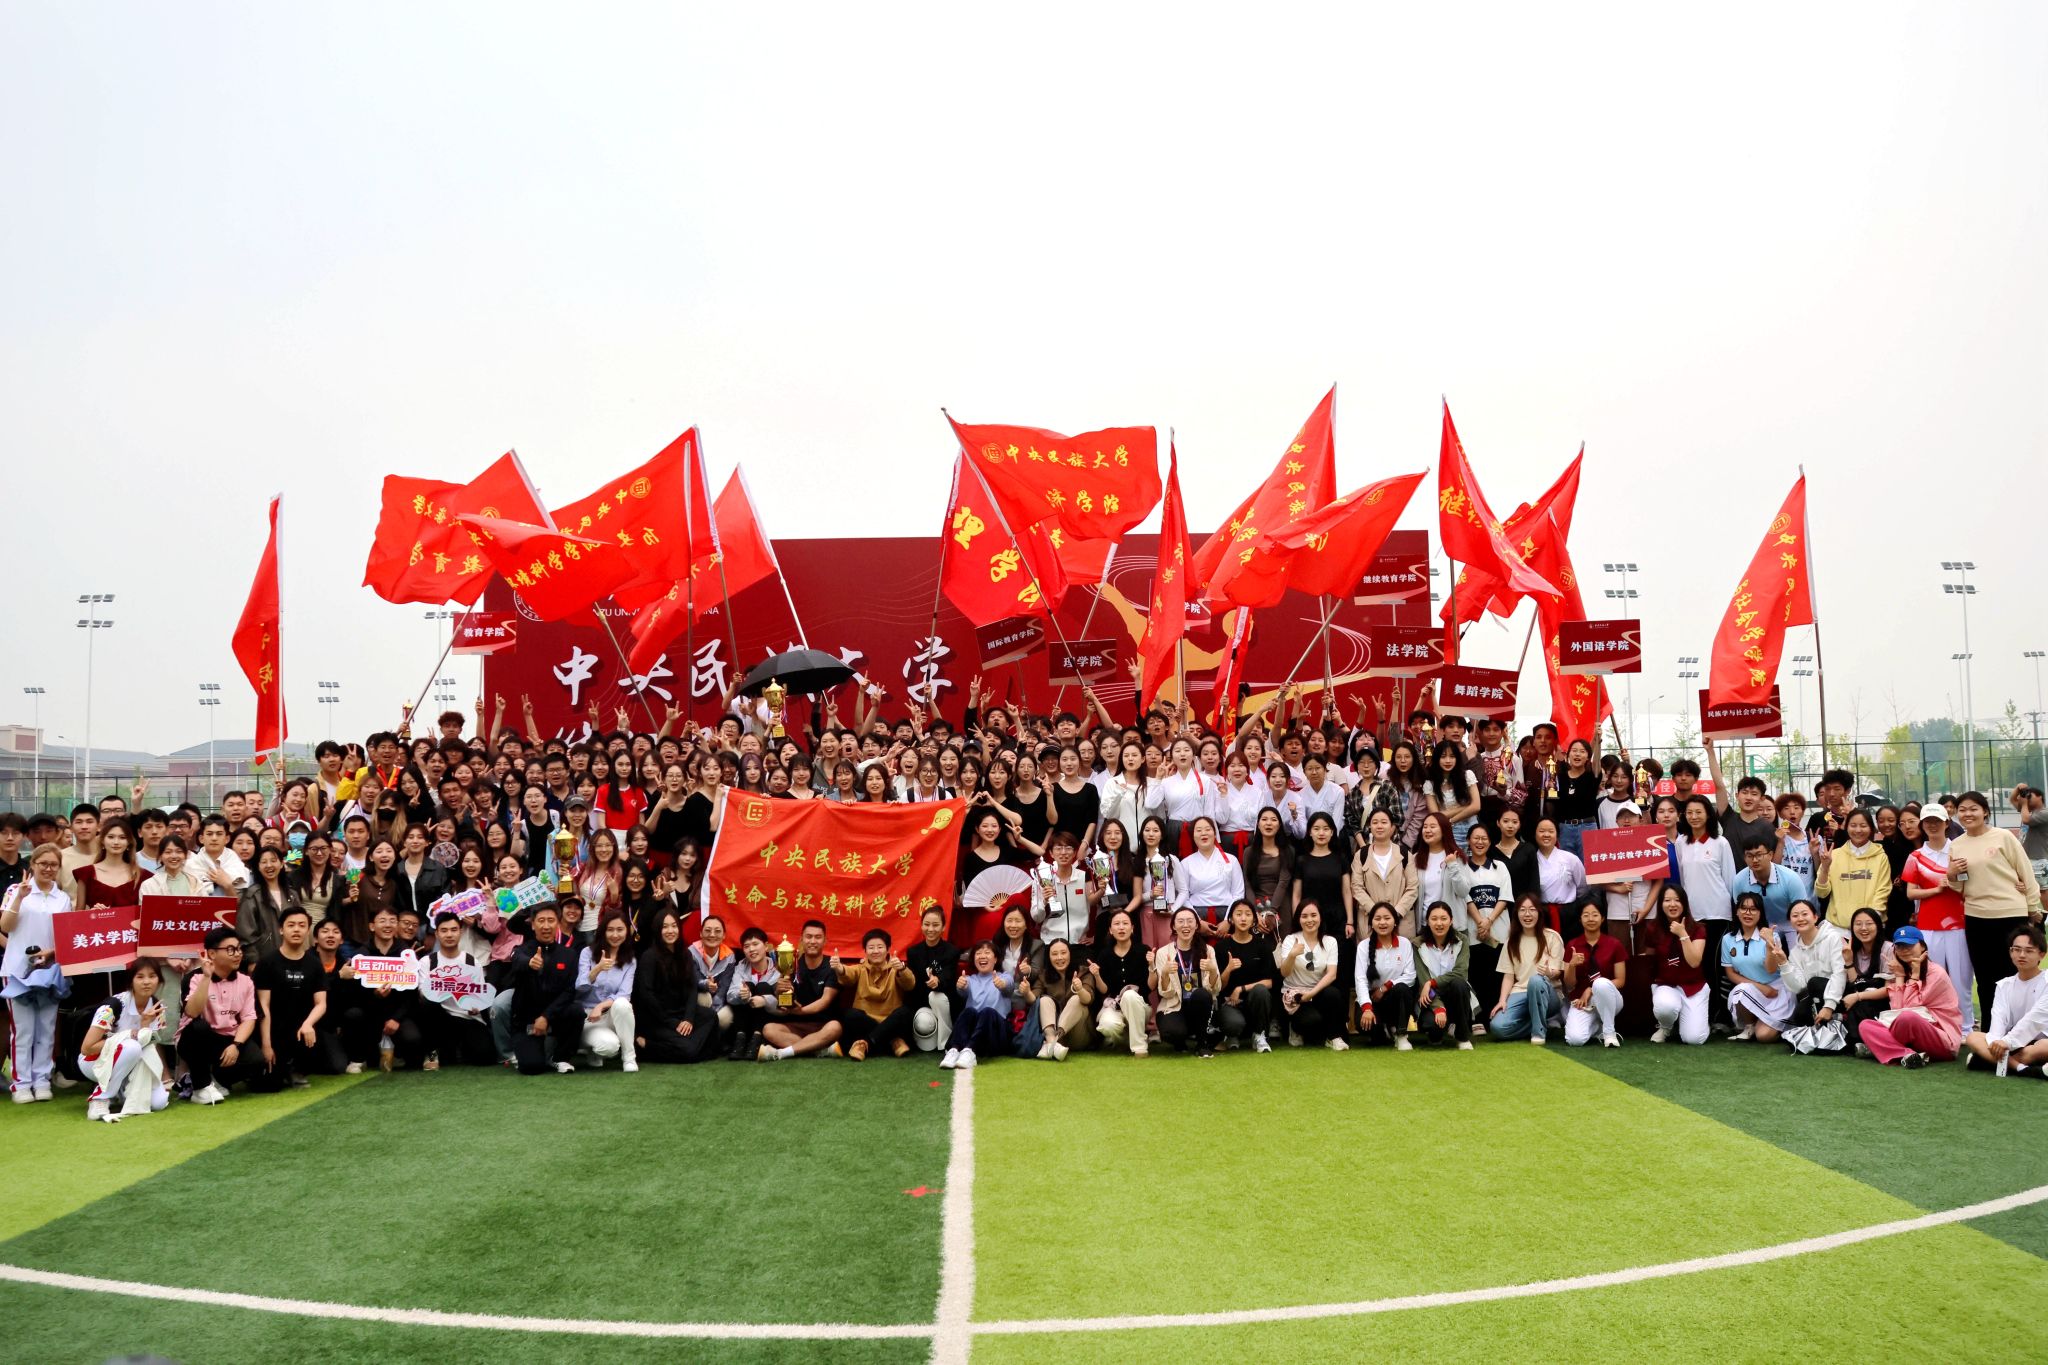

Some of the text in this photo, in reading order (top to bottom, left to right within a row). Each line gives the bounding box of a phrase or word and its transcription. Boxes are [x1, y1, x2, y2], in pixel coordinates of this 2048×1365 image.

[1006, 444, 1128, 468] 中央民族大学
[1363, 573, 1417, 584] 继续教育学院
[463, 627, 505, 637] 教育学院
[987, 628, 1036, 650] 国际教育学院
[1386, 643, 1429, 658] 法学院
[1570, 640, 1630, 652] 外国语学院
[1063, 655, 1102, 667] 理学院
[1454, 684, 1504, 700] 舞蹈学院
[1707, 707, 1772, 717] 民族学与社会学学院
[760, 840, 914, 876] 中央民族大学
[1591, 848, 1661, 862] 哲学与宗教学学院
[152, 920, 223, 931] 历史文化学院
[72, 928, 139, 949] 美术学院
